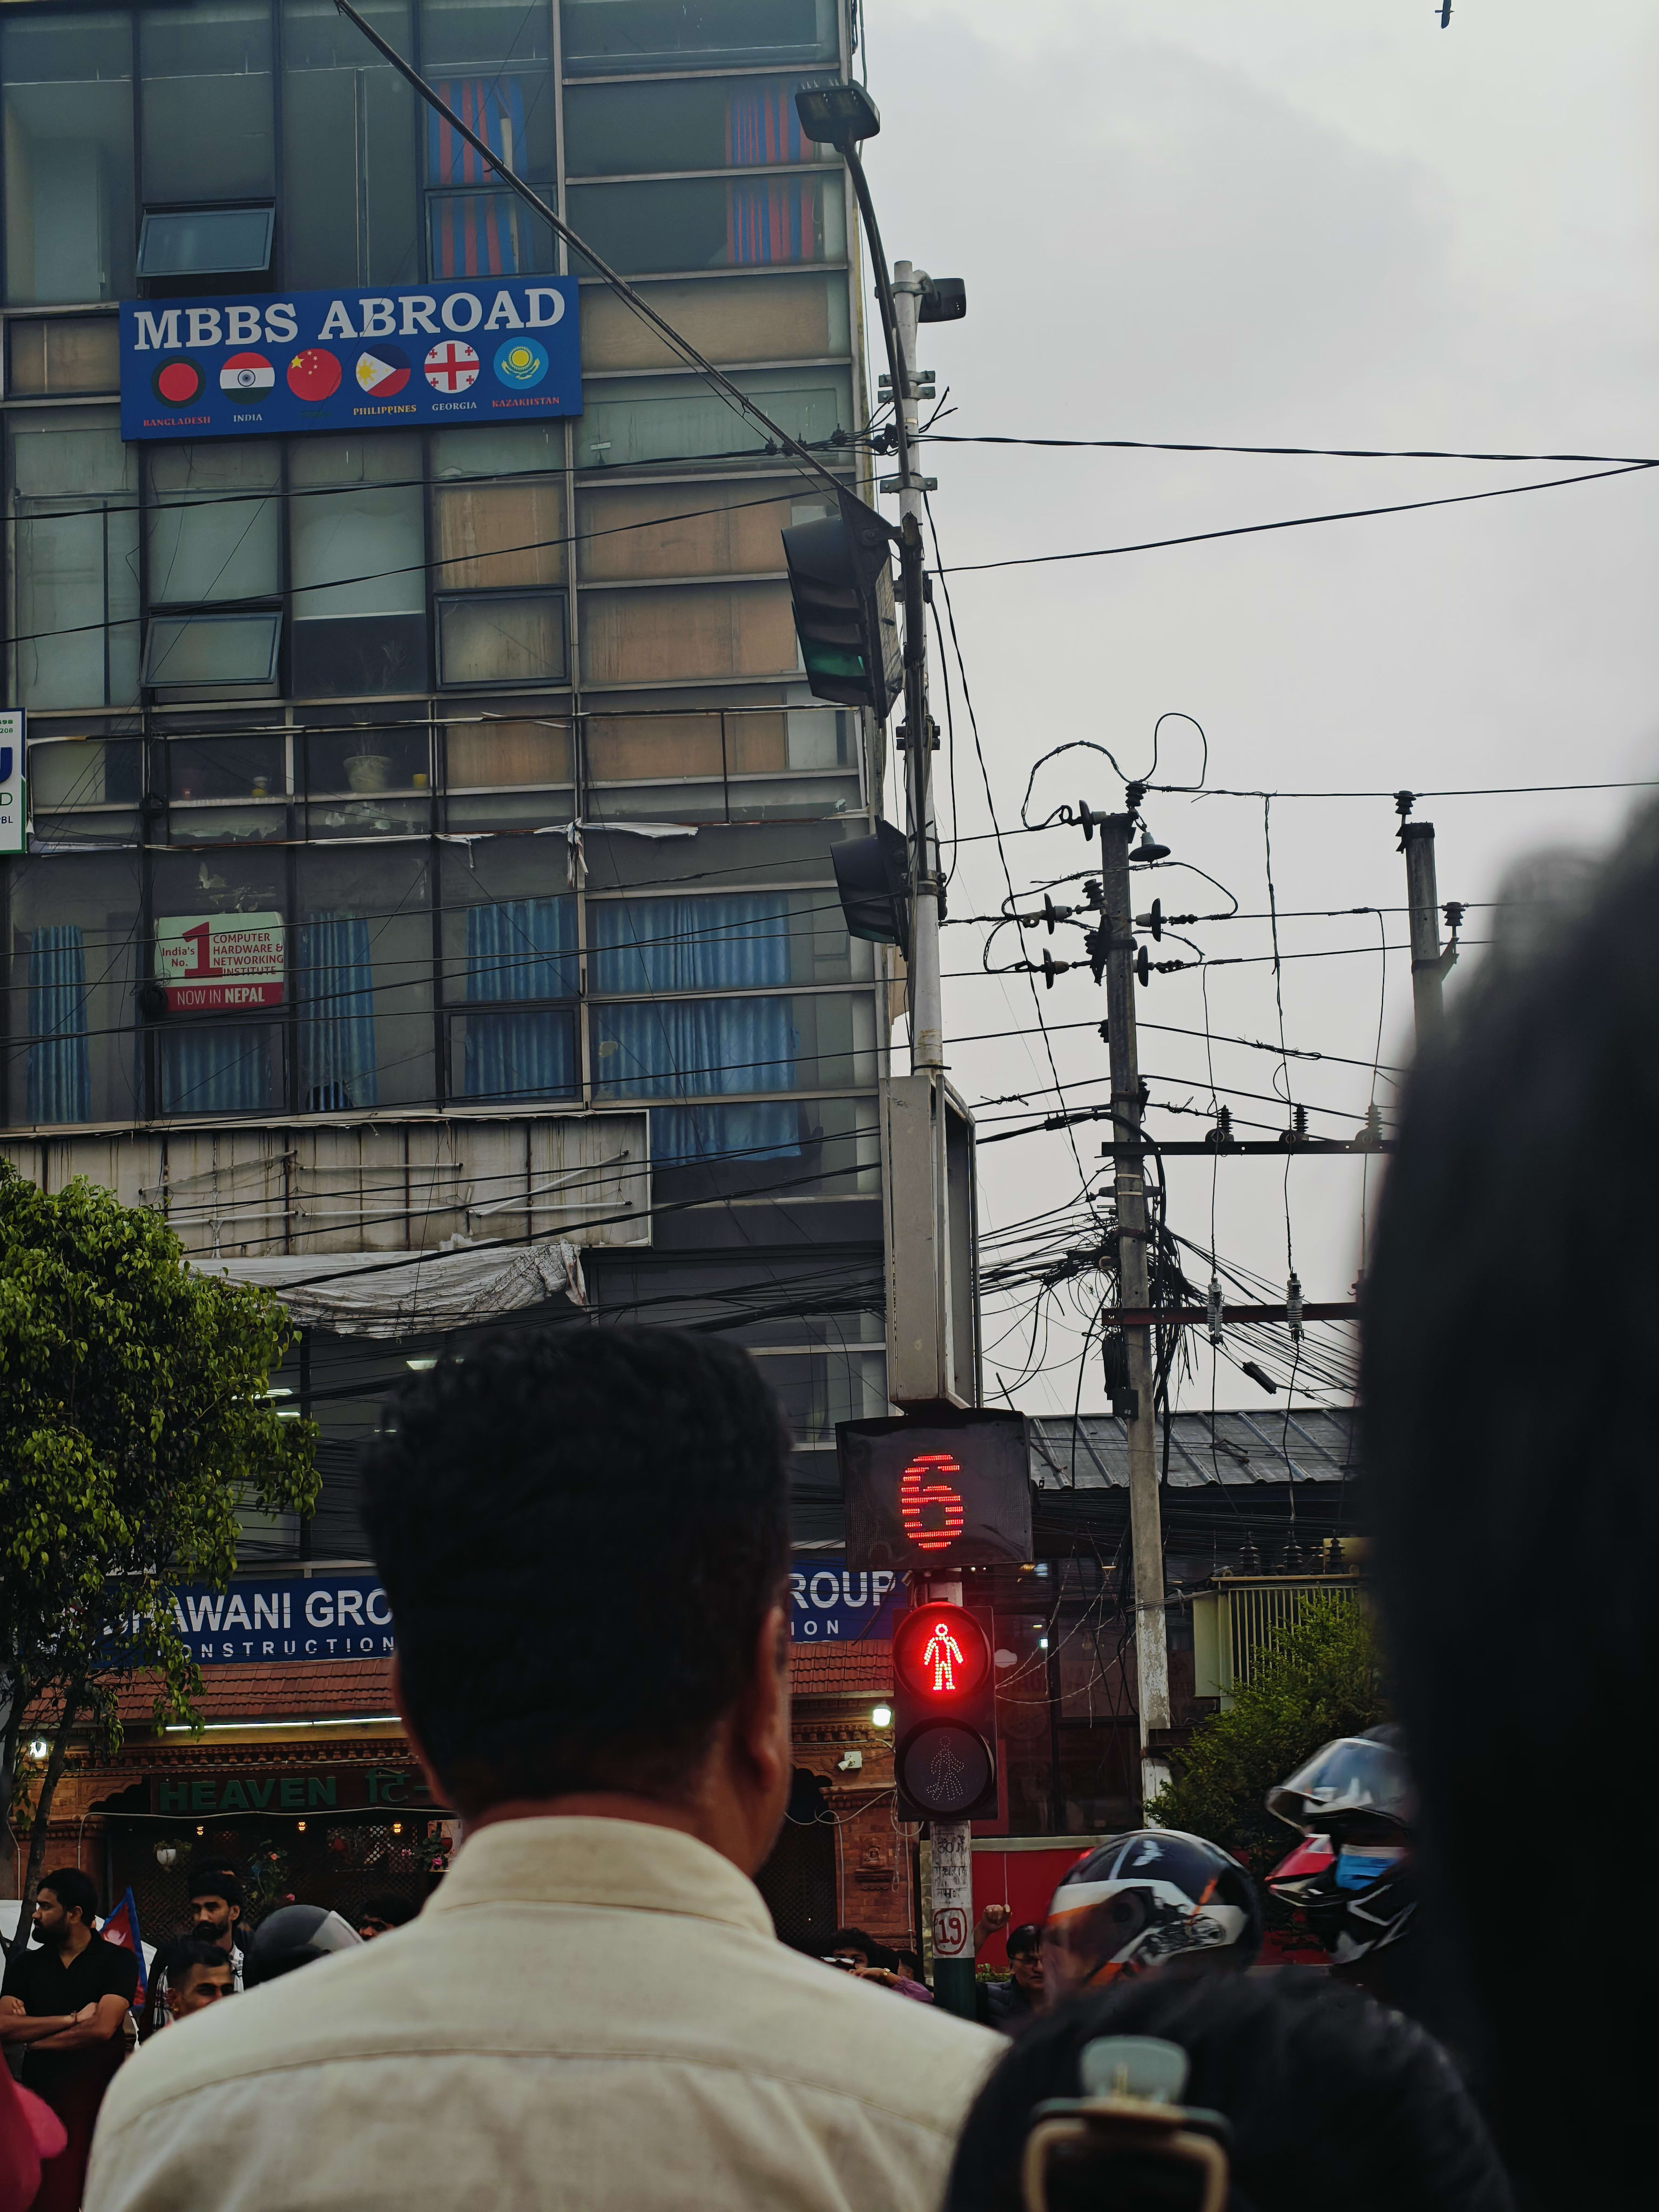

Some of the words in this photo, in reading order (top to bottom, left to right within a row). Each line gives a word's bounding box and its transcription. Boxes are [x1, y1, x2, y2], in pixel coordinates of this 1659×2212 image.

[133, 303, 298, 350] MBBS
[318, 287, 565, 340] ABROAD
[353, 404, 417, 415] PHILIPPINES
[432, 402, 477, 411] GEORGIA
[143, 416, 211, 427] BANGLADESH
[233, 414, 262, 422] INDIA
[213, 933, 271, 943] COMPUTER
[163, 947, 195, 956] India's
[172, 959, 188, 967] No.
[182, 922, 222, 979] 1
[213, 944, 273, 955] HARDWARE
[276, 943, 283, 952] &
[213, 955, 284, 966] NETWORKING
[224, 966, 276, 976] INSTITUTE
[177, 990, 206, 1006] NOW
[210, 989, 221, 1004] IN
[225, 987, 265, 1003] NEPAL
[901, 1455, 964, 1549] 6
[789, 1571, 896, 1608] ROUP
[158, 1636, 394, 1658] ONSTRUCTION
[160, 1777, 336, 1811] HEAVEN
[939, 1918, 962, 1945] 19
